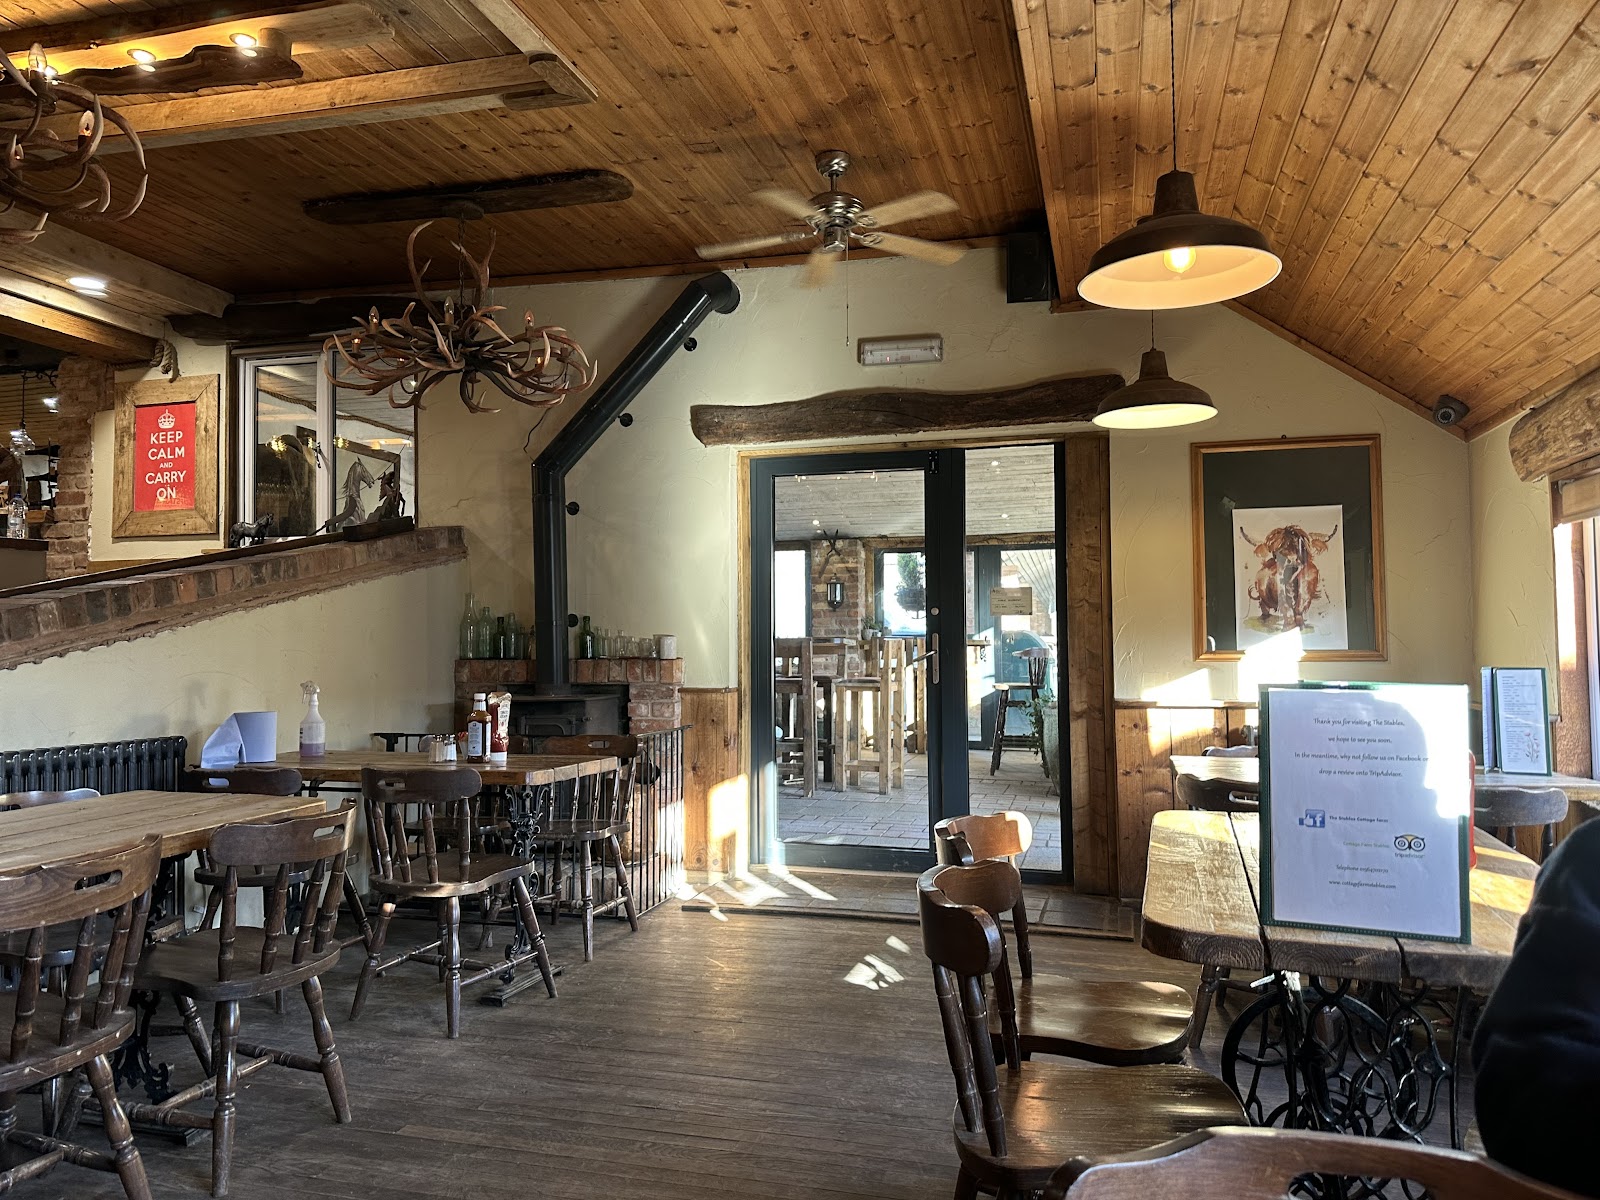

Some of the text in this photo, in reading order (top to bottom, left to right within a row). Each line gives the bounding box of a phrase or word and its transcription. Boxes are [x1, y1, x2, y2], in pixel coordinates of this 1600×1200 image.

[150, 431, 183, 445] KEEP
[148, 446, 185, 460] CALM
[145, 470, 187, 485] CARRY
[156, 486, 177, 500] ON
[1342, 718, 1350, 726] for
[1350, 719, 1372, 727] visiting
[1336, 735, 1350, 743] hope
[1340, 753, 1351, 761] why
[1361, 754, 1379, 762] follow
[1318, 768, 1333, 776] drop
